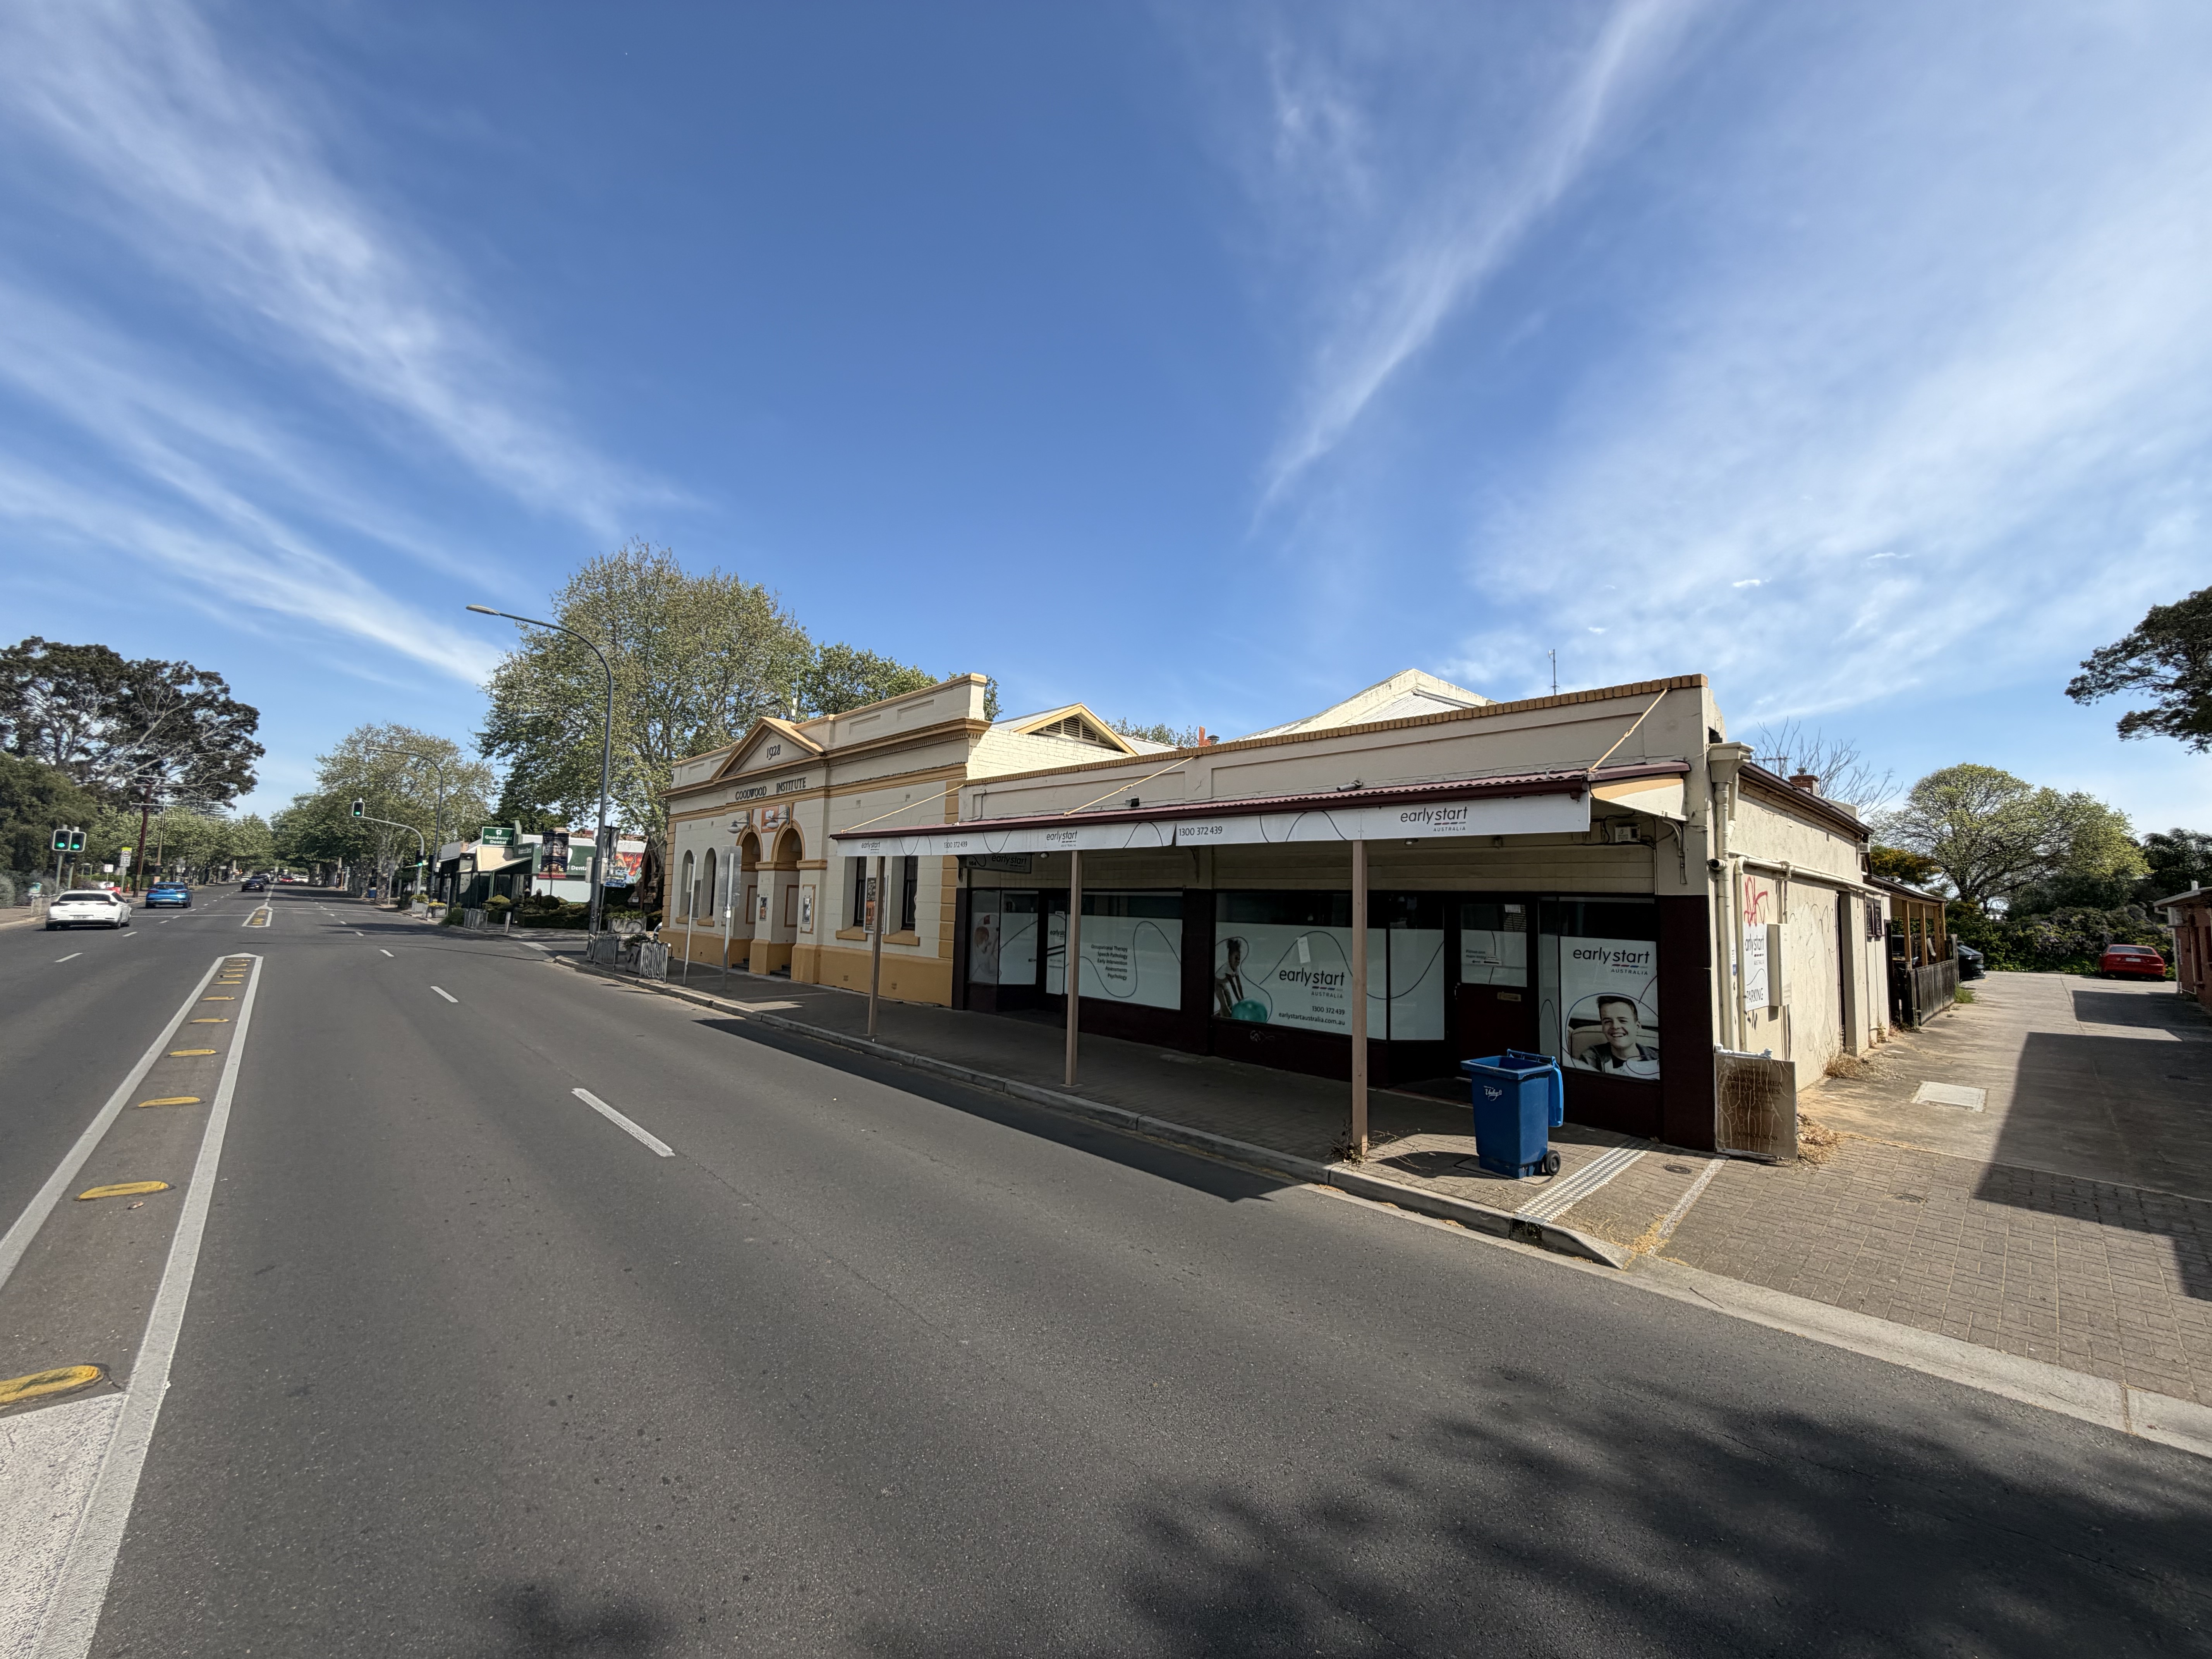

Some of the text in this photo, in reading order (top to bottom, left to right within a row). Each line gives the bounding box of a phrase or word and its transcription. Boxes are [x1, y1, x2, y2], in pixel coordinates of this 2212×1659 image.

[767, 744, 781, 760] 1928
[735, 777, 806, 800] GOODWOOD INSTITUTE
[1179, 826, 1223, 836] 1300 372 439
[1747, 988, 1763, 1004] PARKING
[1279, 1012, 1345, 1025] earlystartaustralia.com.au
